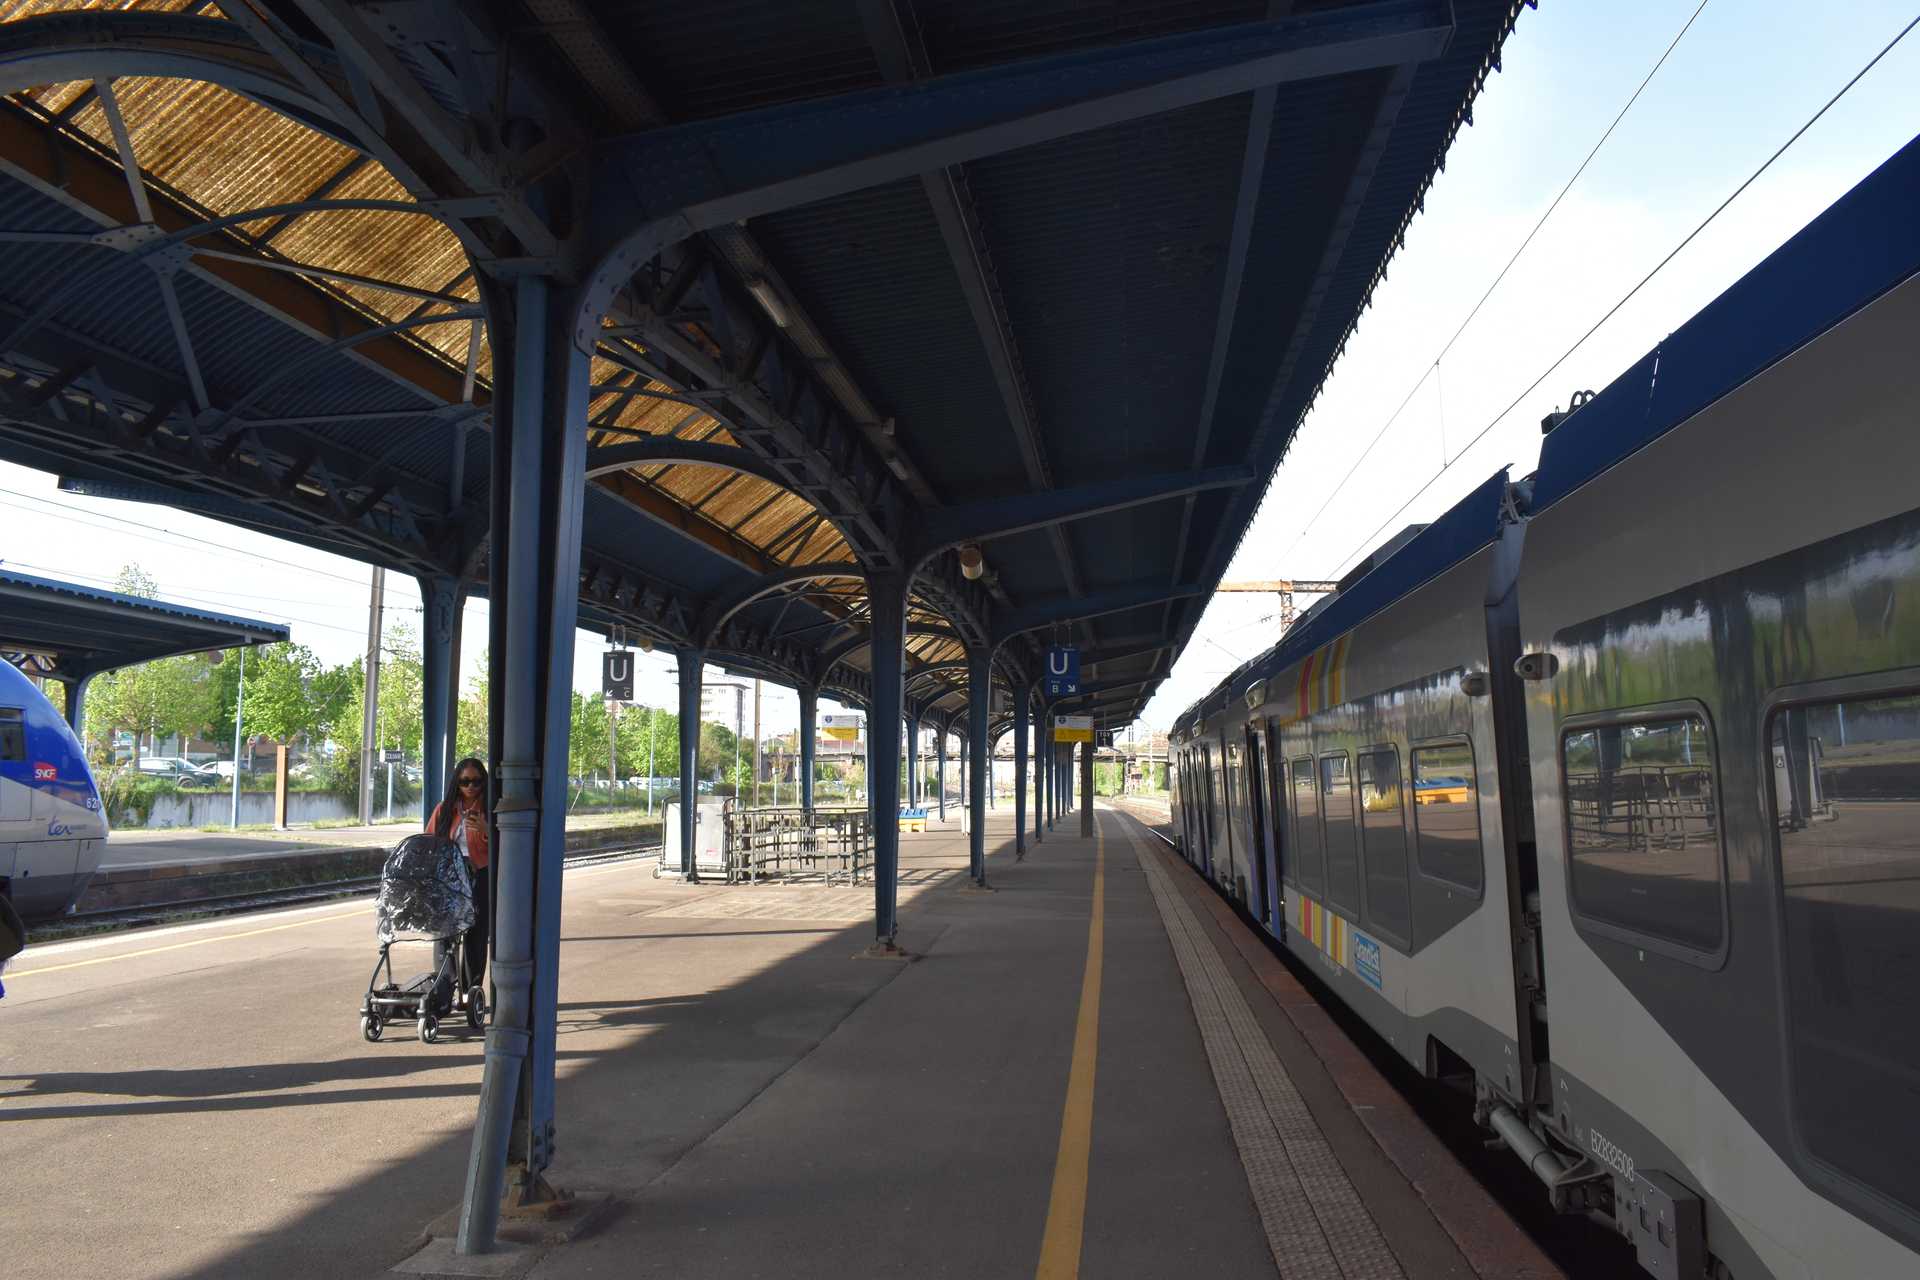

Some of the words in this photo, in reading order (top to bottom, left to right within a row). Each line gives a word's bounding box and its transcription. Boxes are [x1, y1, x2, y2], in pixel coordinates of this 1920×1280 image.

[610, 659, 627, 681] U
[1050, 652, 1068, 675] U
[1052, 685, 1059, 693] B
[34, 769, 57, 779] SNCF
